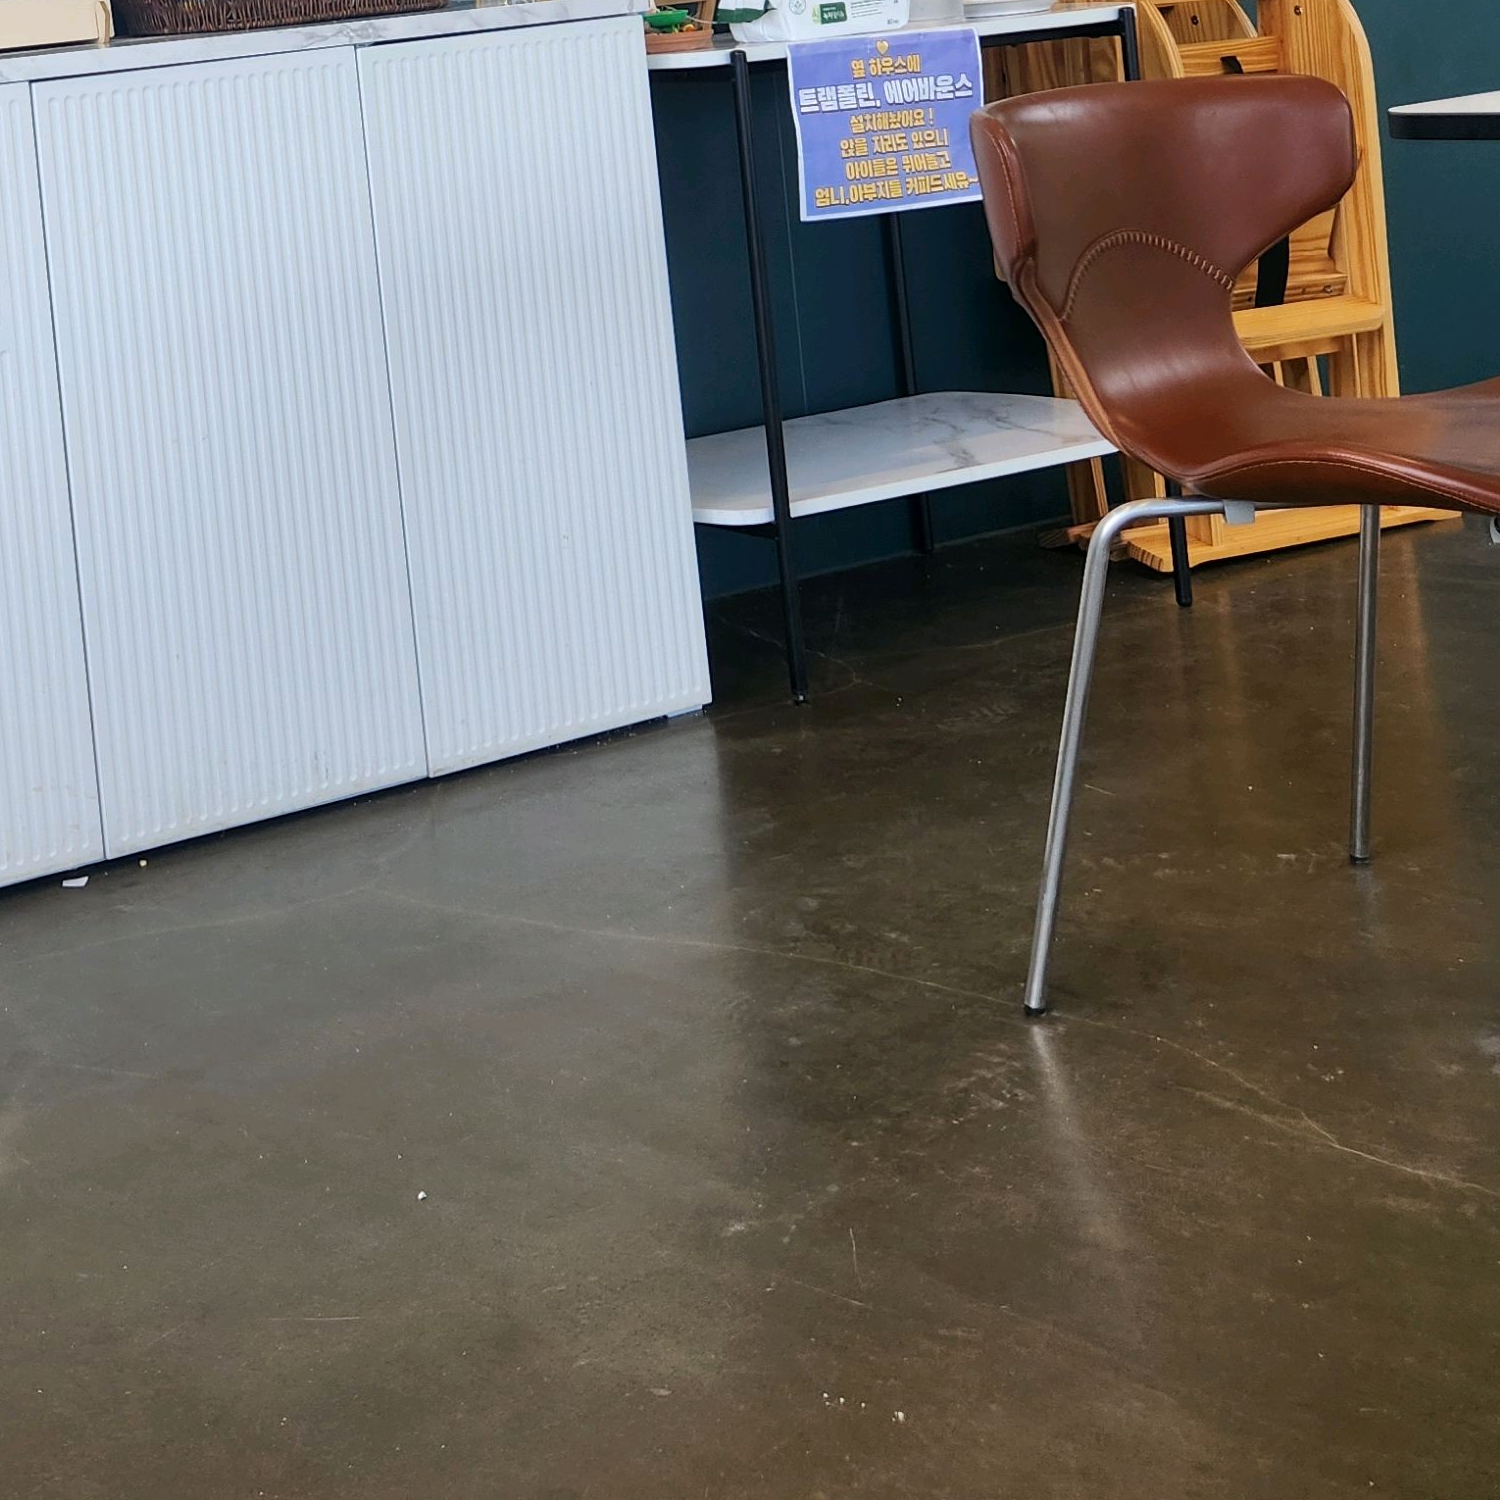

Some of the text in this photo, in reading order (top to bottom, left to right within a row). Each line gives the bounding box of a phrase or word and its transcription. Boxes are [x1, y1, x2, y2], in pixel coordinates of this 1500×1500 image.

[851, 53, 921, 79] 옆 하우스에
[799, 74, 973, 114] 트램폴린, 에어바운스
[840, 128, 949, 158] 앉을 자리도 있으니
[845, 151, 951, 181] 아이들은 뛰어놀고
